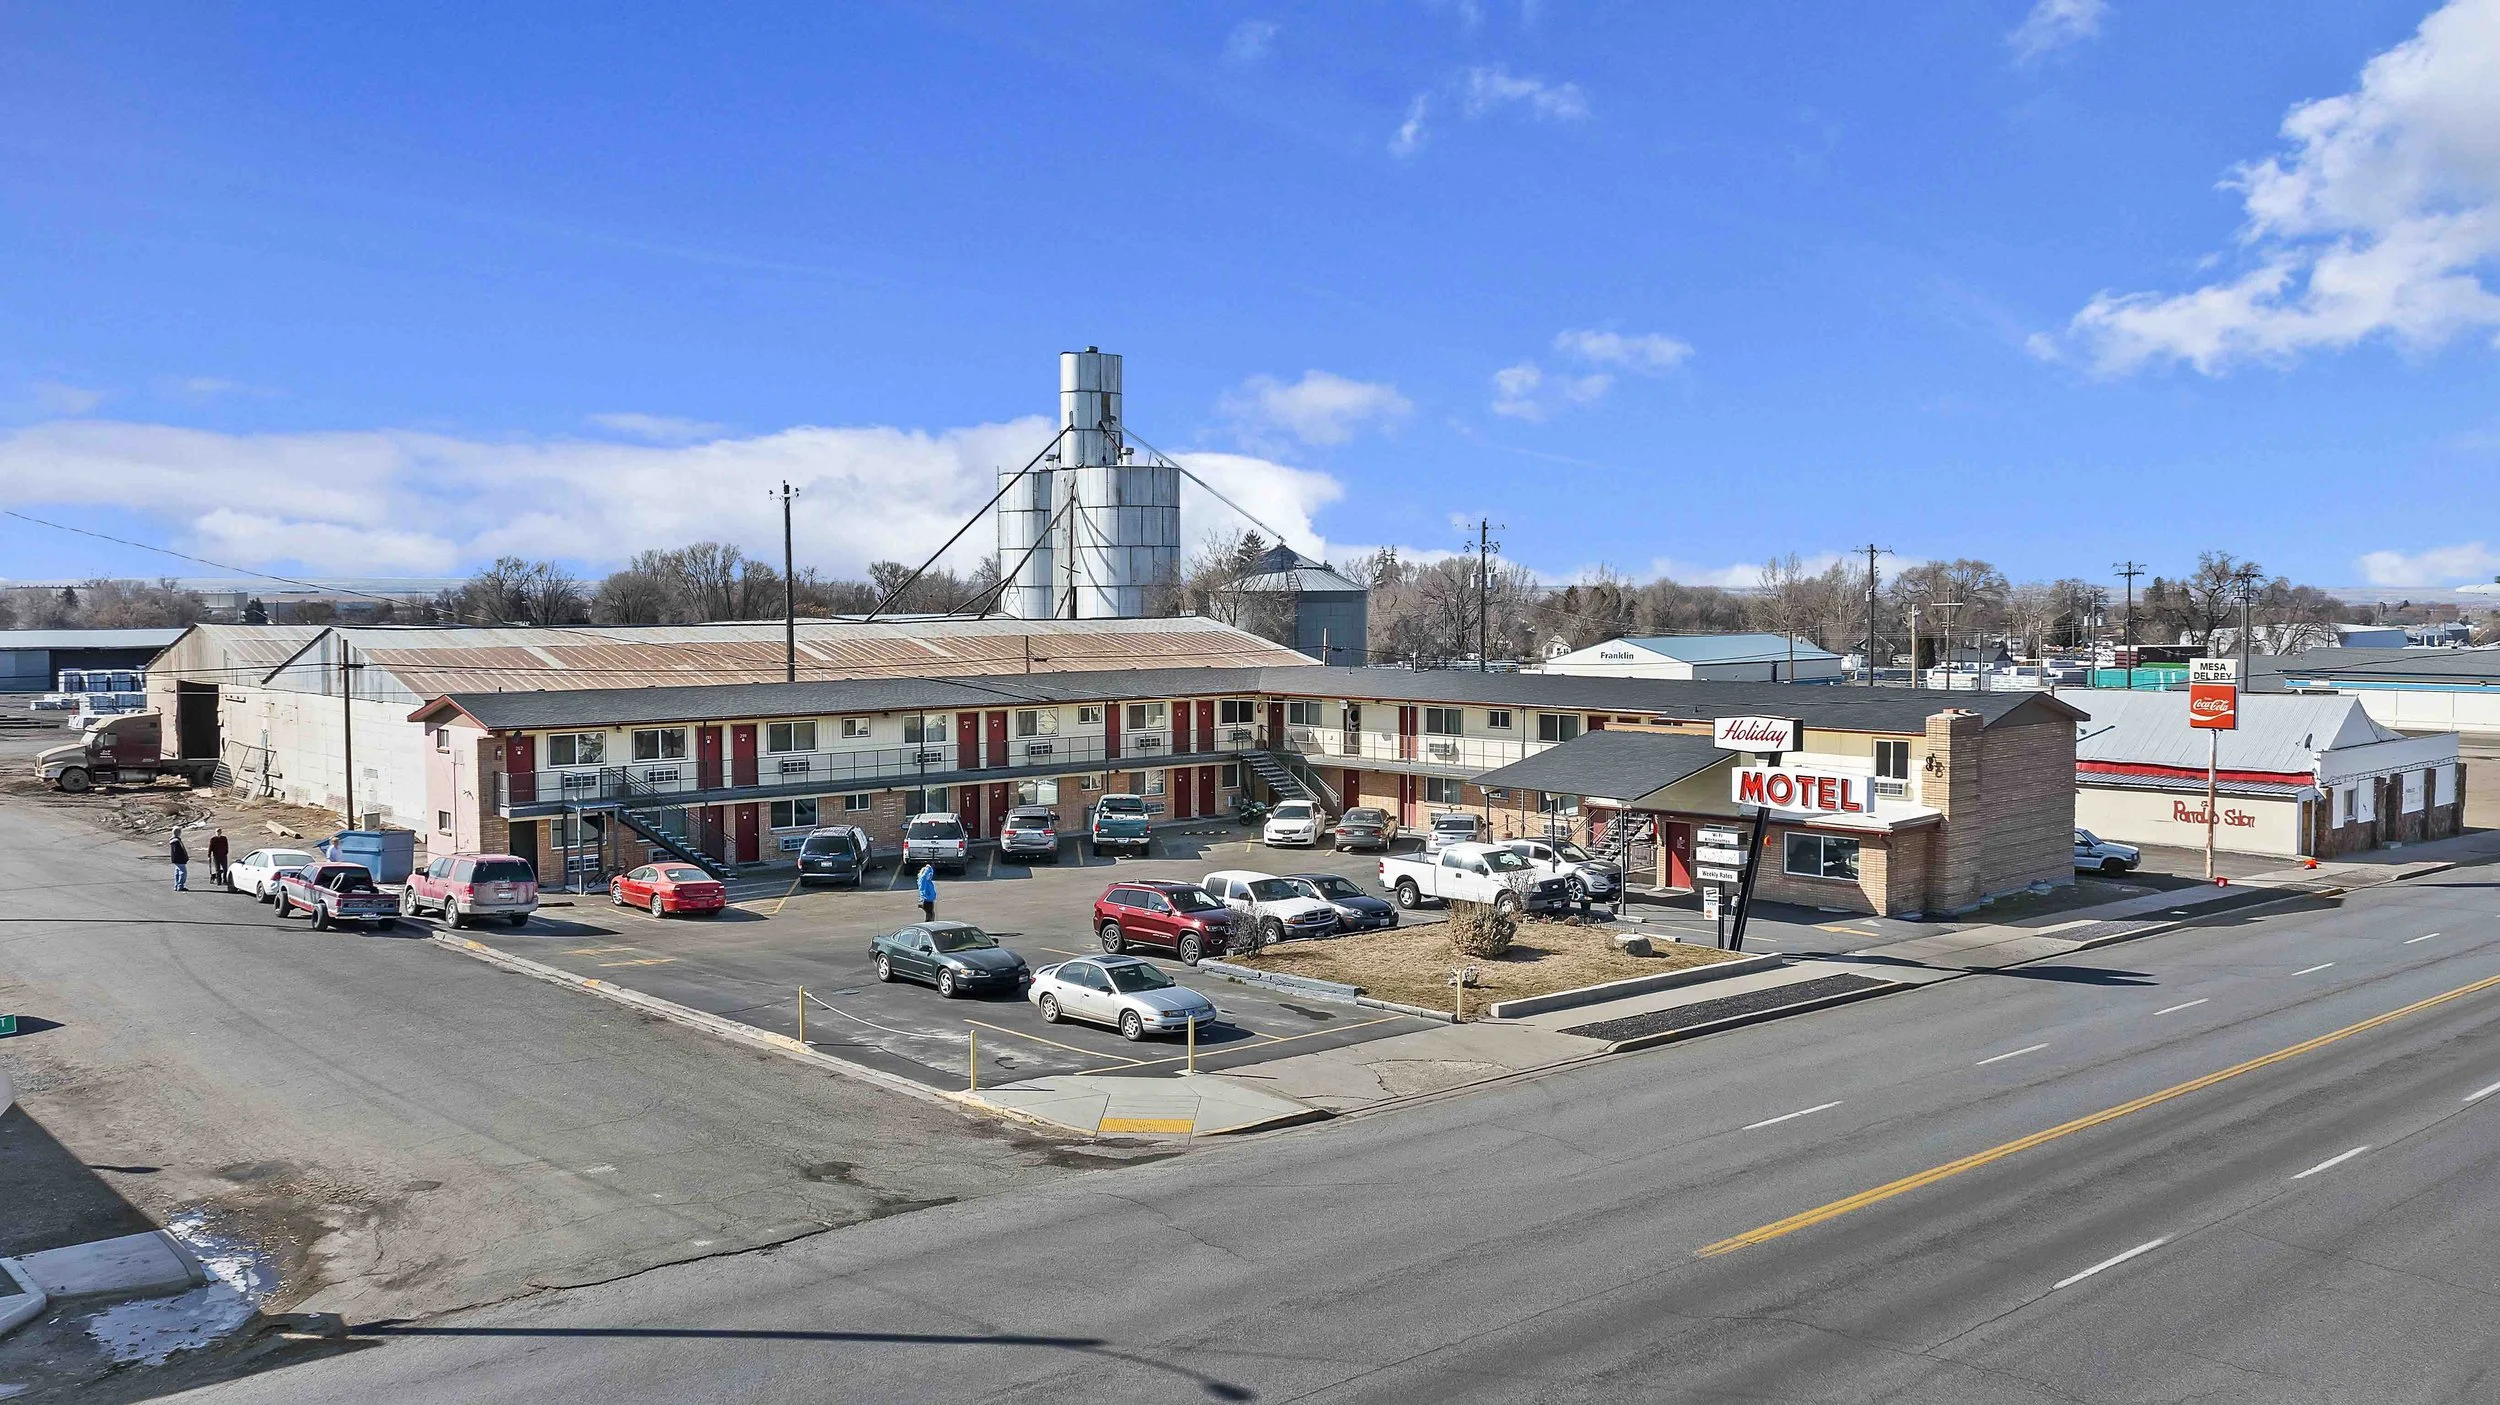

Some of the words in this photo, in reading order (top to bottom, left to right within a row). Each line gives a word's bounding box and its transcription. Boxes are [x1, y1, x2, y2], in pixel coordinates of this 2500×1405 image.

[1600, 651, 1634, 660] Franklin
[2200, 662, 2227, 671] MESA
[2193, 672, 2210, 680] DEL
[2213, 672, 2232, 680] REY
[1719, 719, 1788, 749] Holiday
[1739, 771, 1861, 812] MOTEL
[2224, 808, 2255, 828] Salon
[1702, 870, 1718, 879] Weekly
[1719, 872, 1733, 880] Rates
